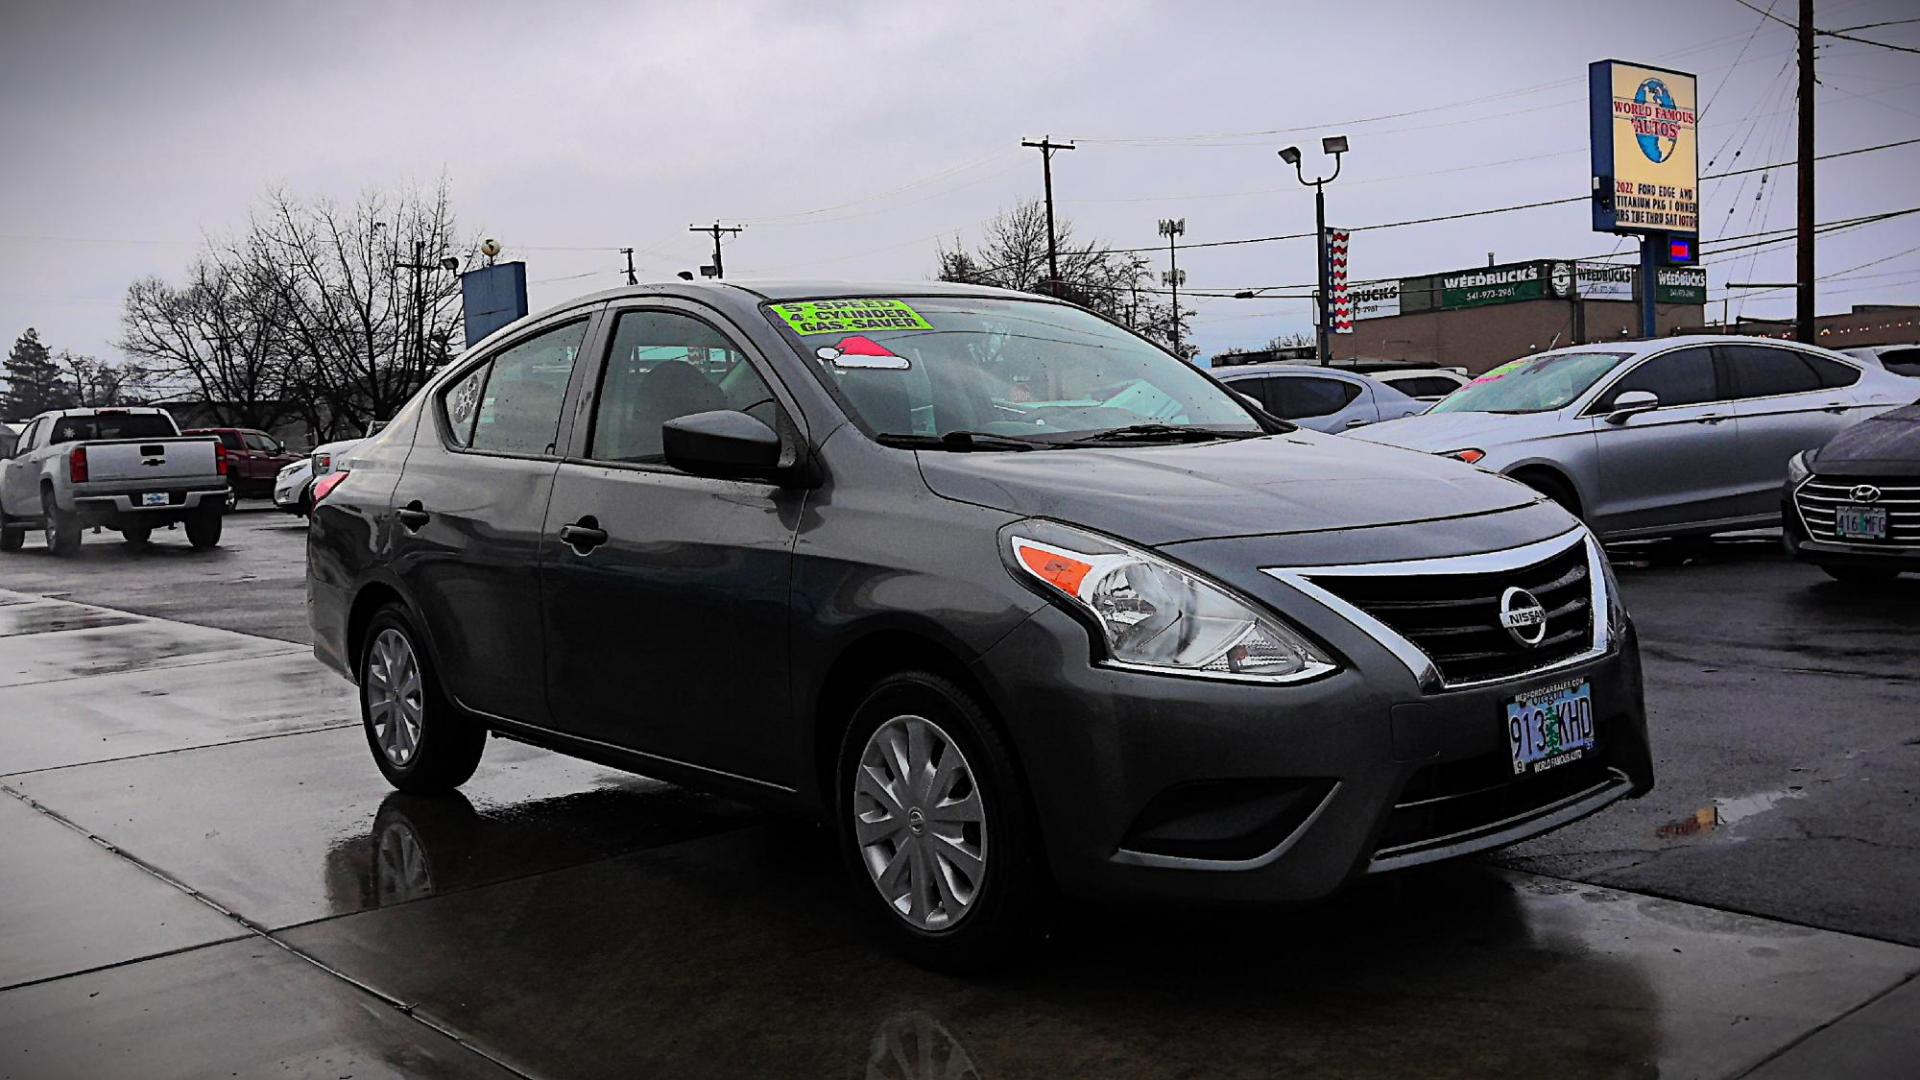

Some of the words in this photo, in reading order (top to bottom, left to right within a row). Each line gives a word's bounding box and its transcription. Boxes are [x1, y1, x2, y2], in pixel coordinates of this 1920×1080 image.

[1614, 101, 1652, 117] WORLD
[1655, 107, 1694, 124] FAMOUS
[1616, 181, 1633, 194] 2022
[1638, 183, 1656, 197] FORD
[1659, 186, 1675, 199] EDGE
[1616, 195, 1650, 209] TITANIUM
[1652, 199, 1666, 211] PKG
[1631, 210, 1645, 223] TUE
[1646, 211, 1663, 224] THRU
[1665, 213, 1678, 226] SAT
[1444, 267, 1538, 288] WEEDBUCKS
[1578, 268, 1631, 283] WEEDBUCKS
[1509, 609, 1544, 624] NISSAN
[1510, 709, 1547, 759] 913
[1556, 697, 1592, 746] KHD
